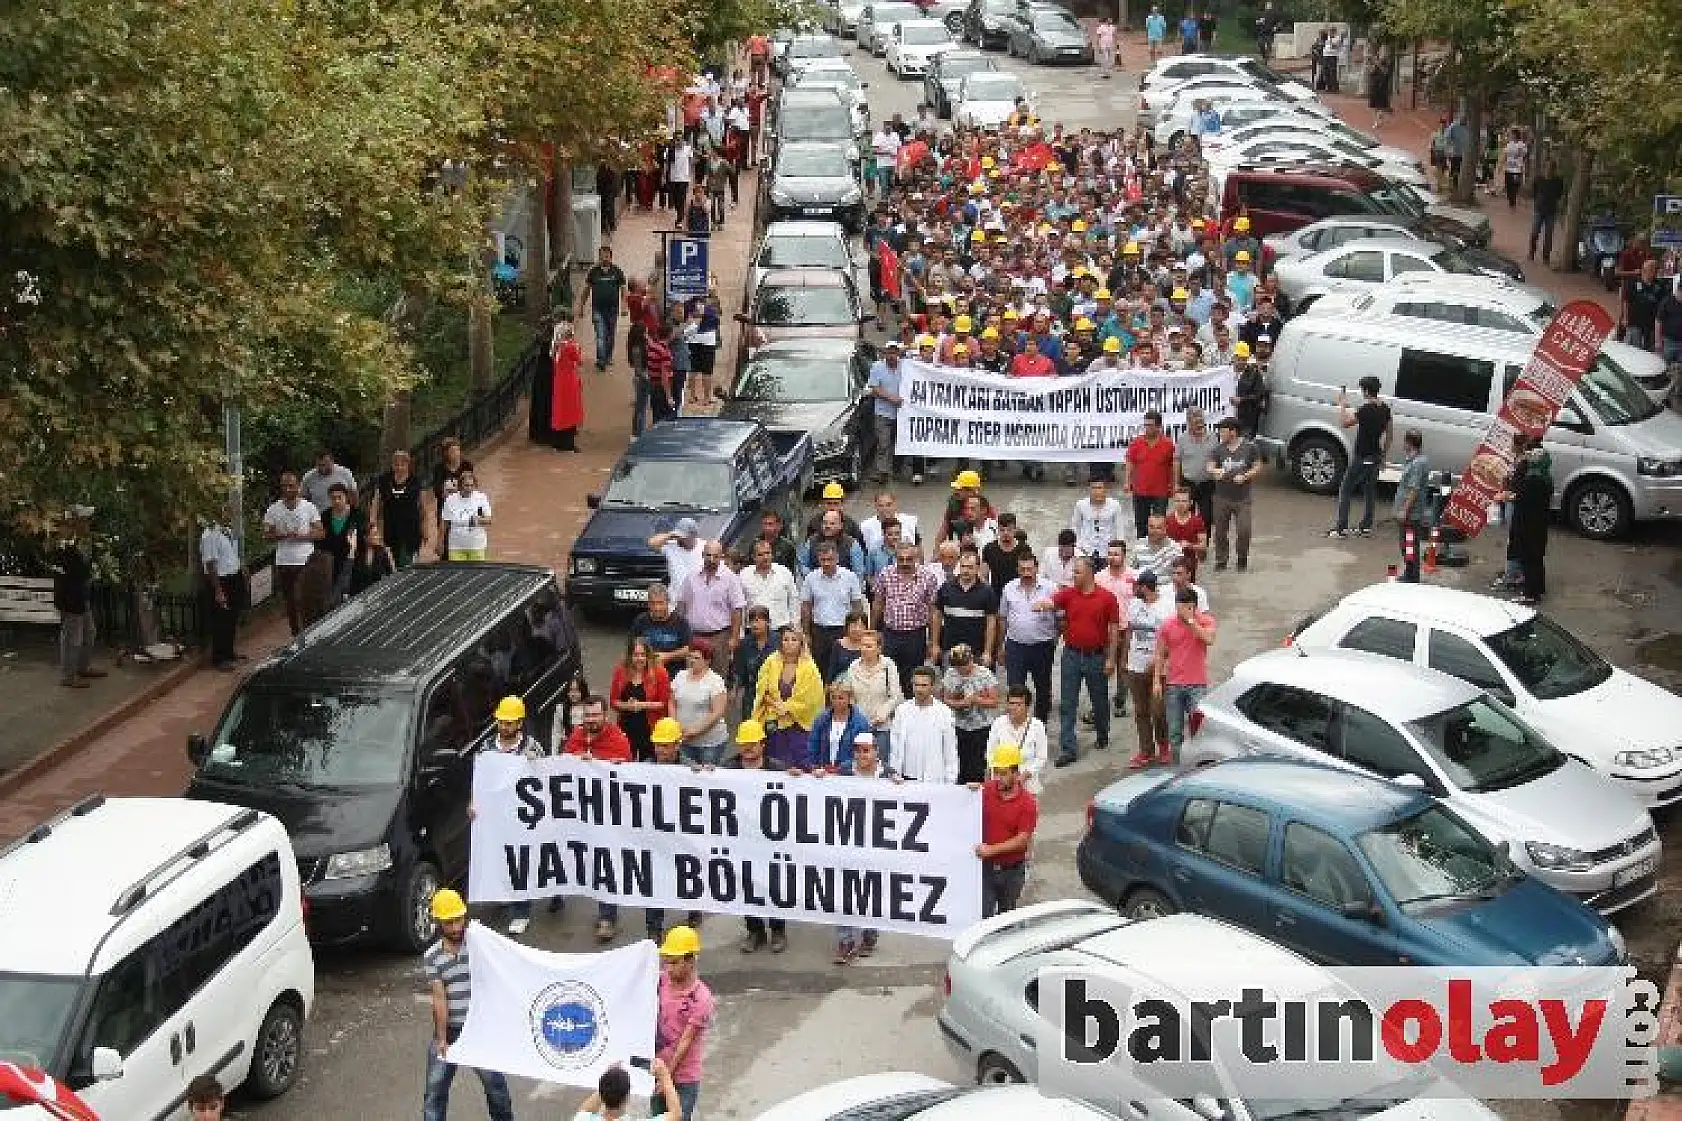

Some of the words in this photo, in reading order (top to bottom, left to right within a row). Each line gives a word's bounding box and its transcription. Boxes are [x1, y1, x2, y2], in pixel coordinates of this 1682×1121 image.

[681, 241, 699, 266] P
[515, 770, 739, 836] ŞEHİTLER
[759, 781, 931, 853] ÖLMEZ
[504, 842, 652, 898] VATAN
[674, 847, 948, 925] BÖLÜNMEZ
